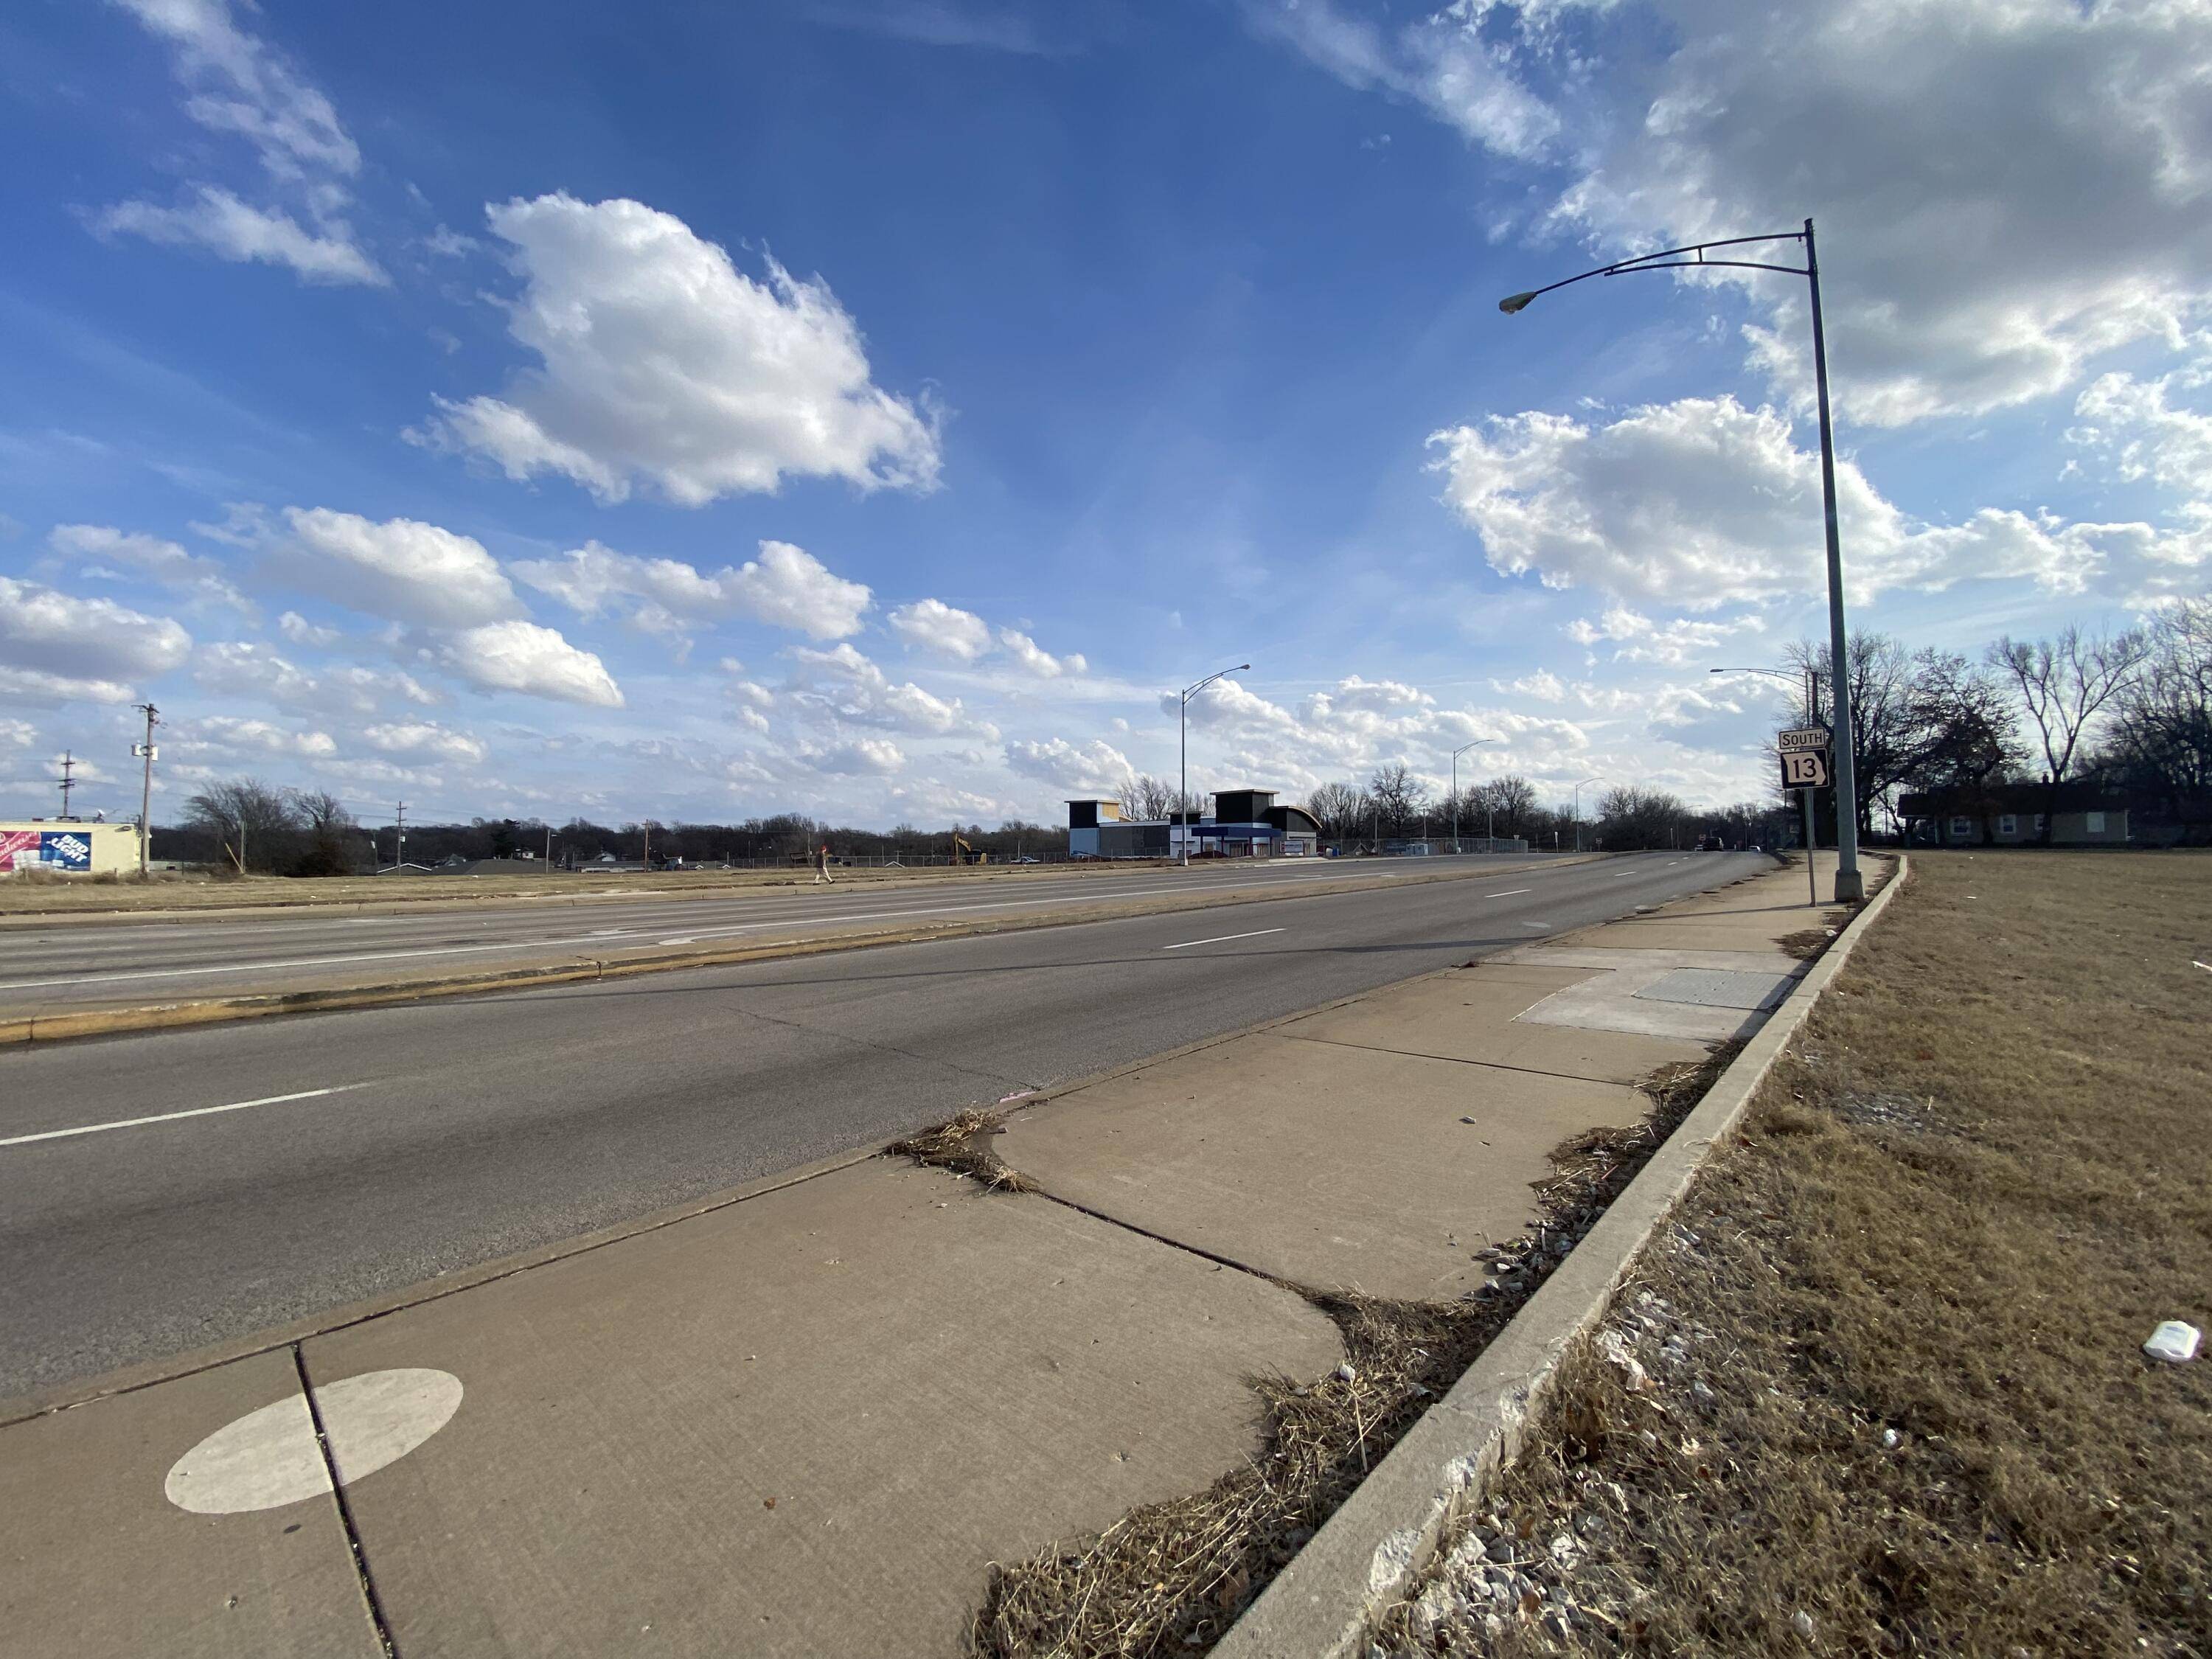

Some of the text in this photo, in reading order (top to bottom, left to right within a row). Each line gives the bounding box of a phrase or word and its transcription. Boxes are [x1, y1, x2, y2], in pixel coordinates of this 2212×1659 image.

[1782, 733, 1823, 745] SOUTH
[1793, 758, 1817, 779] 13
[46, 837, 88, 862] LIGHT
[60, 834, 88, 853] BUD
